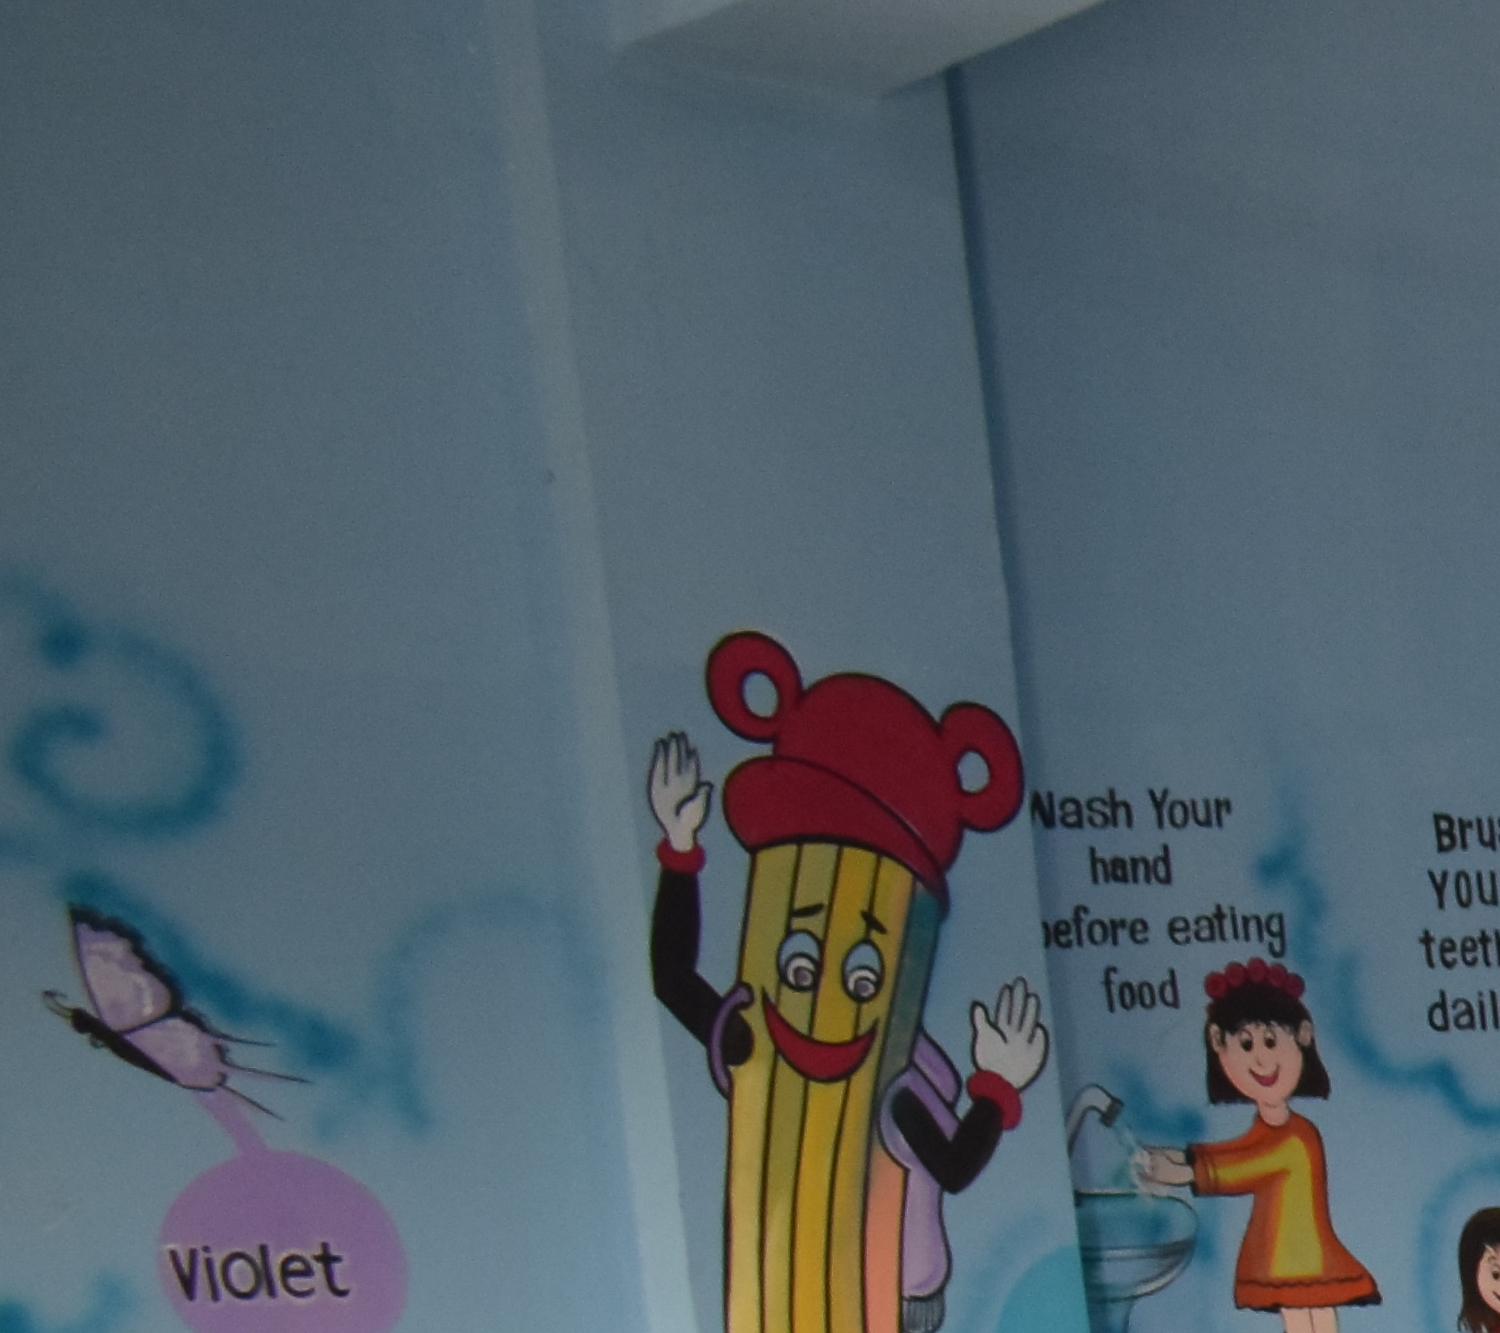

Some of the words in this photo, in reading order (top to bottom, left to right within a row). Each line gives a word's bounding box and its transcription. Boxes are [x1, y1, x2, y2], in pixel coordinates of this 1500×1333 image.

[1148, 788, 1232, 829] Your
[1089, 844, 1172, 885] hand
[1041, 905, 1149, 949] efore
[1168, 903, 1286, 958] eating
[1104, 965, 1180, 1013] food
[168, 1241, 350, 1302] Violet
